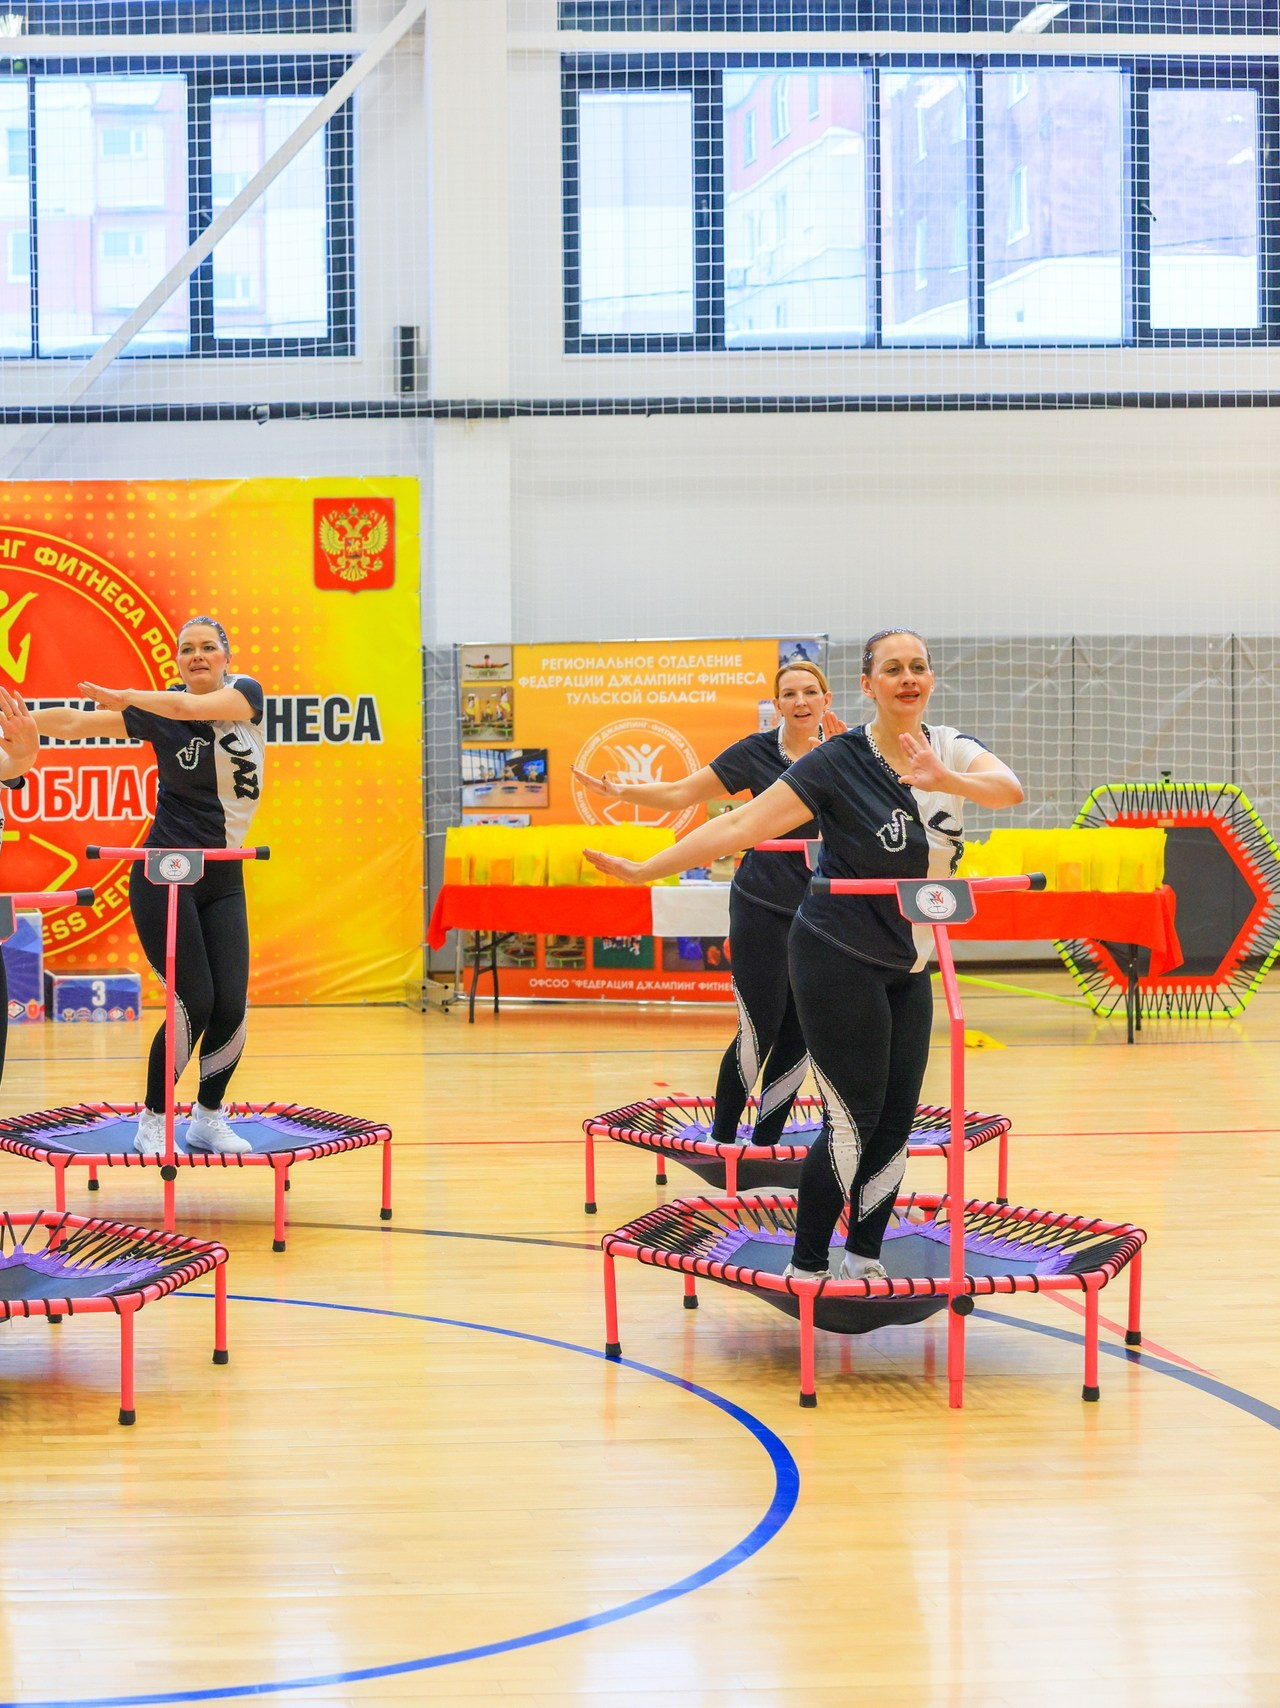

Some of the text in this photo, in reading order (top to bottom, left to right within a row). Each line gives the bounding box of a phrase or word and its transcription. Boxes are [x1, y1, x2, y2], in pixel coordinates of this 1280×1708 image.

[33, 545, 146, 629] ФИТНЕСА
[541, 654, 743, 671] РЕГИОНАЛЬНОЕ ОТДЕЛЕНИЕ
[517, 671, 767, 689] ФЕДЕРАЦИИ ДЖАМПИНГ ФИТНЕСА
[566, 689, 717, 705] ТУЛЬСКОЙ ОБЛАСТИ
[263, 695, 384, 746] НЕСА
[219, 732, 260, 801] JAZZ
[91, 980, 106, 1007] 3
[528, 978, 570, 989] ОФСОО
[636, 980, 696, 991] ДЖАМПИНГ
